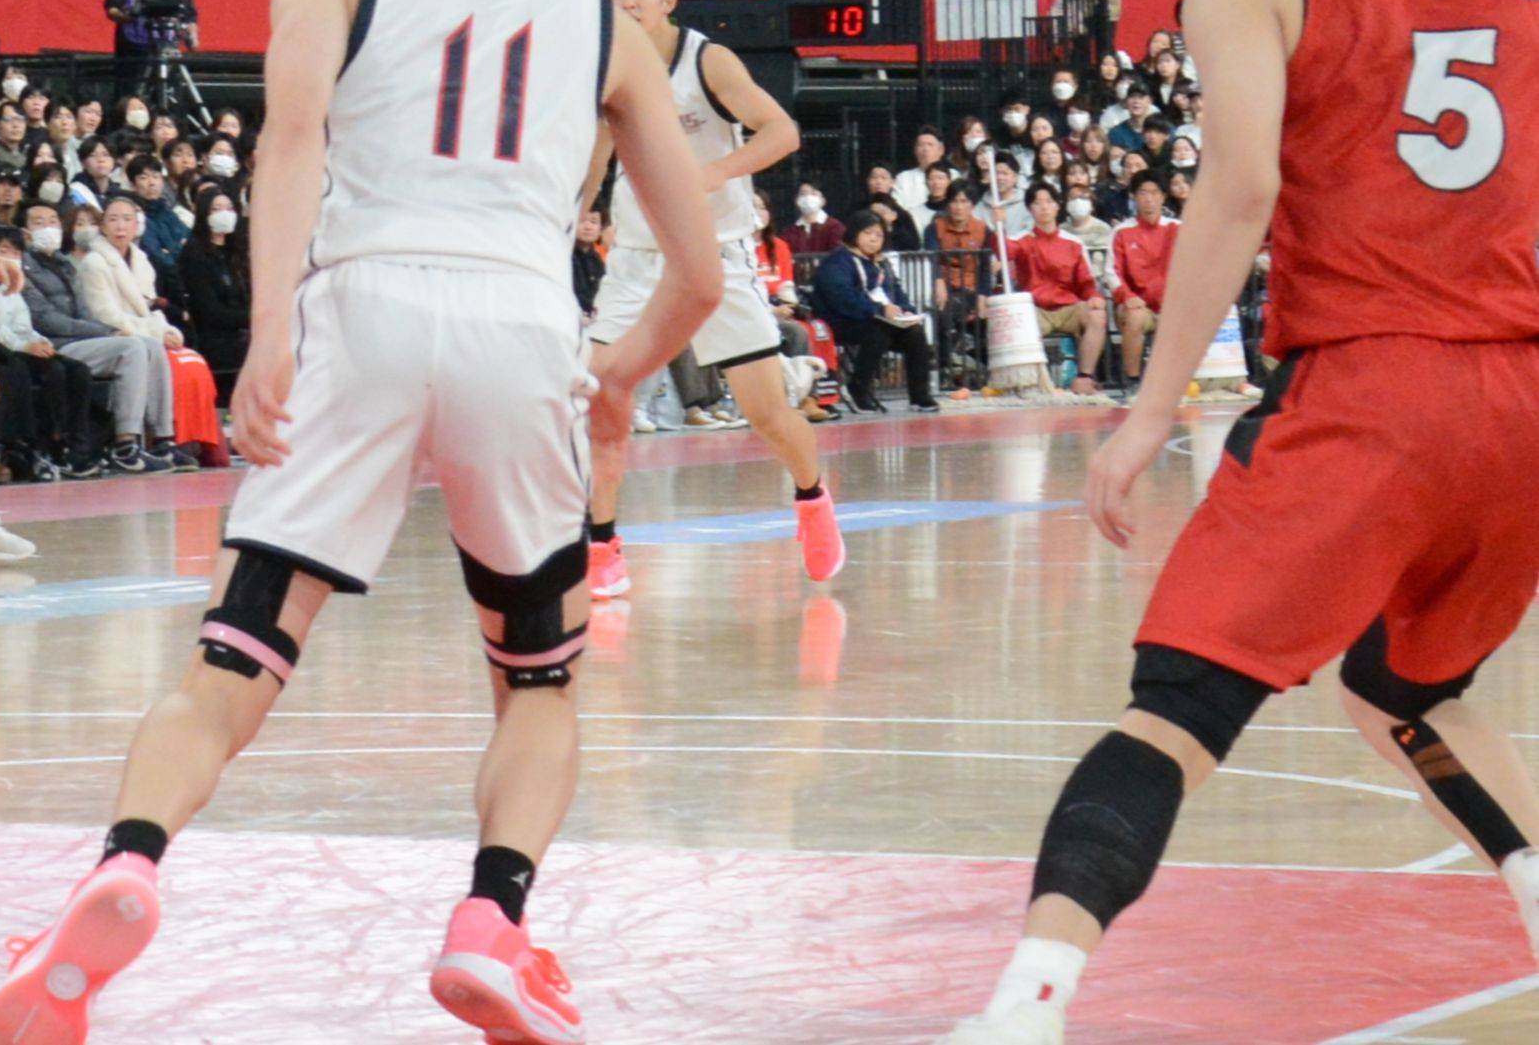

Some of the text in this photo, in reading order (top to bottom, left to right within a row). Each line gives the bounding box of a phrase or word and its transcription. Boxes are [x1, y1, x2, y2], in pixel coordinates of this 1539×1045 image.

[432, 12, 533, 163] 11
[828, 6, 864, 36] 10
[1395, 27, 1506, 193] 5
